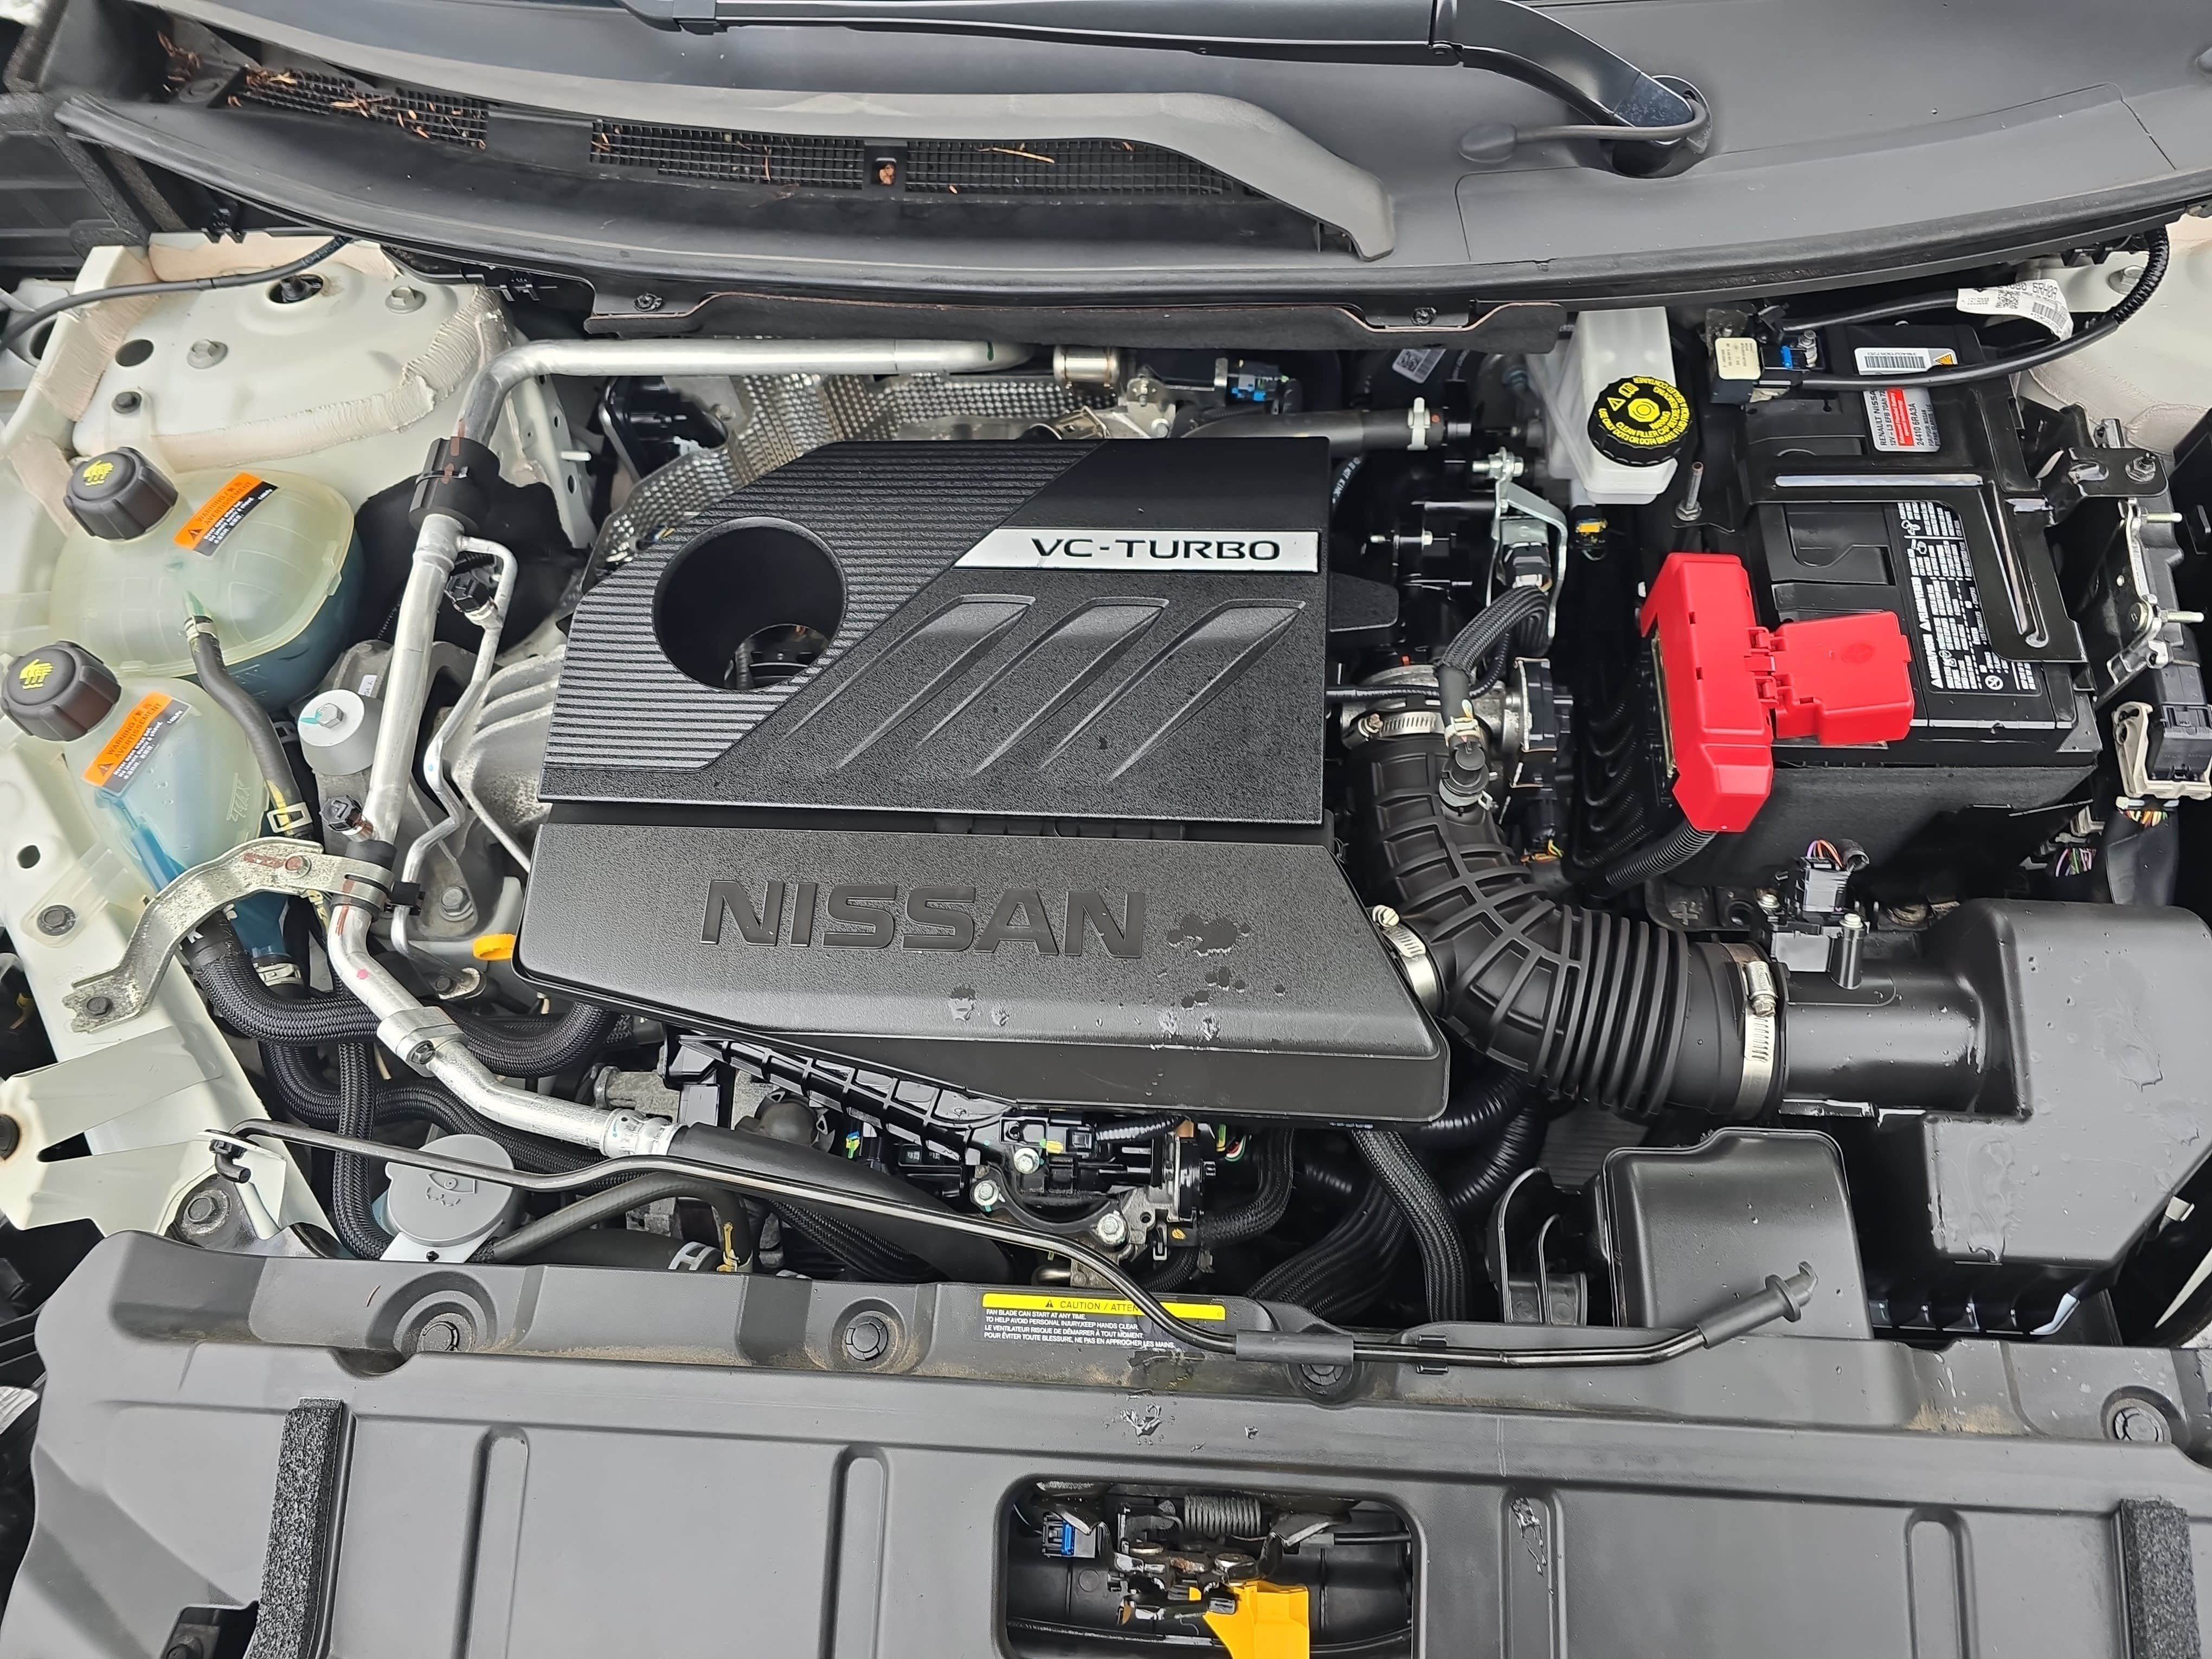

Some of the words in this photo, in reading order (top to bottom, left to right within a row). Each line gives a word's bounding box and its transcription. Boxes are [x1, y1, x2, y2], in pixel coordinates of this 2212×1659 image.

[1880, 397, 1888, 411] 70Ah
[1907, 402, 1919, 425] 6RA3A
[1615, 421, 1636, 435] CLEAN
[1657, 425, 1670, 435] CAP
[1874, 415, 1887, 446] RENAULT
[1913, 426, 1924, 446] 24410
[1032, 537, 1281, 561] VC-TURBO
[106, 721, 136, 755] WARNING
[115, 701, 162, 758] AVERTISSEMENT
[700, 879, 1145, 959] NISSAN
[1059, 1300, 1101, 1310] CAUTION
[992, 1324, 1030, 1333] VENTILATEUR
[1062, 1327, 1095, 1336] DÉMARRER
[1116, 1331, 1144, 1339] MOMENT.
[1001, 1332, 1021, 1340] ÉVITER
[1105, 1338, 1142, 1347] APPROCHER
